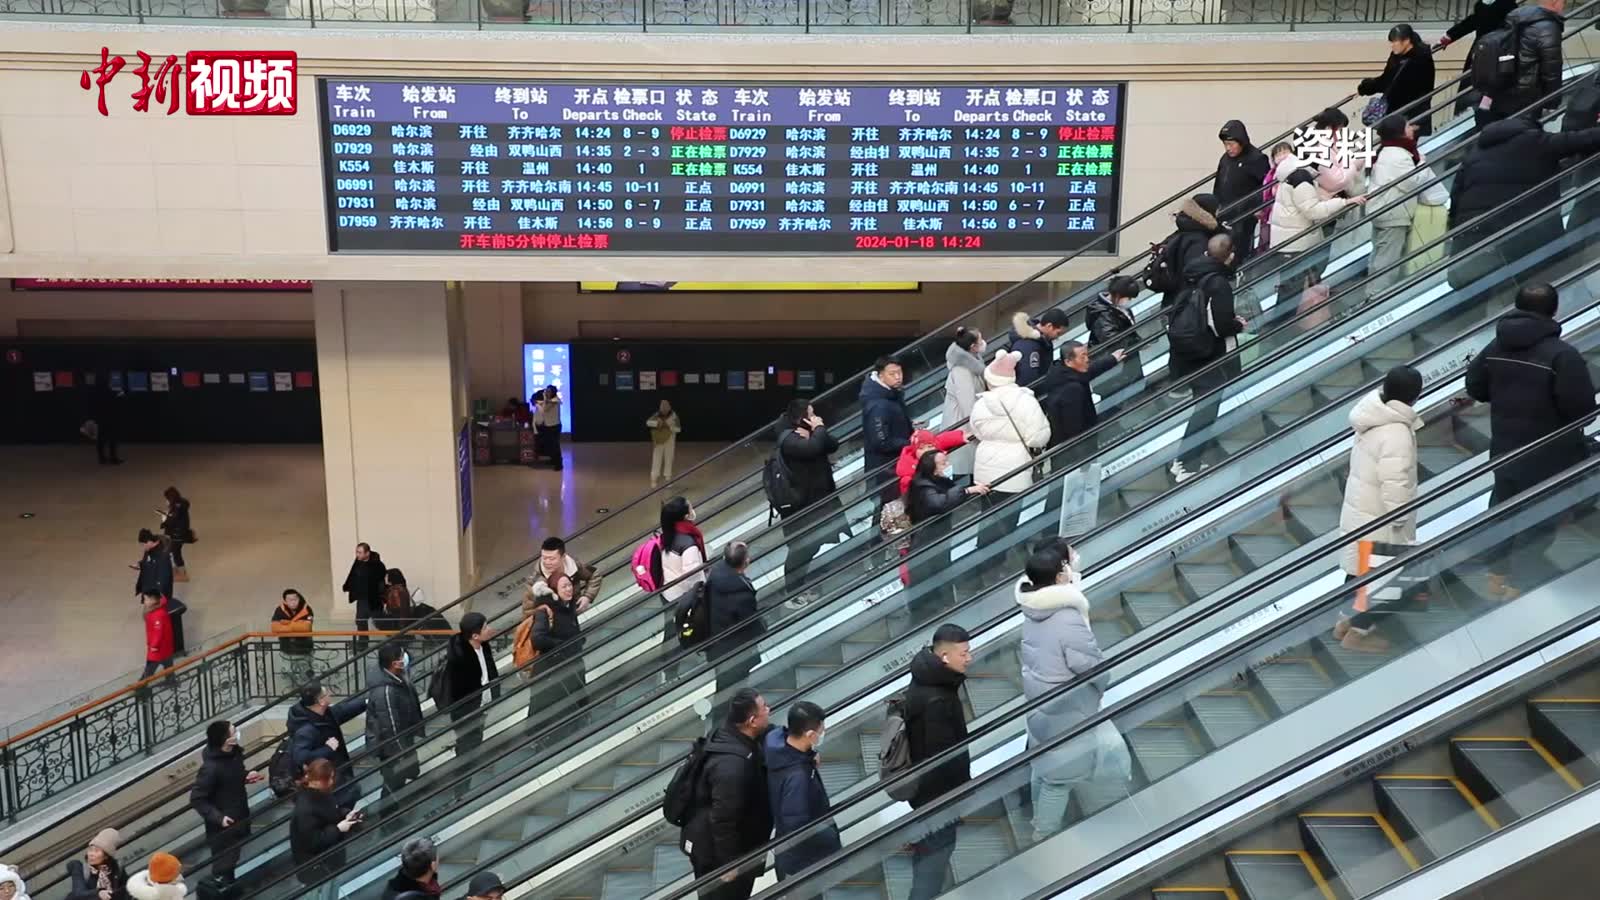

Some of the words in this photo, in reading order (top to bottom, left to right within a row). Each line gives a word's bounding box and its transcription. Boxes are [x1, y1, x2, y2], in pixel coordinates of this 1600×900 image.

[336, 84, 371, 101] 车次
[402, 86, 455, 103] 始发站
[495, 87, 547, 104] 终到站
[574, 88, 608, 104] 开点
[614, 88, 664, 105] 检票口
[735, 88, 768, 106] 车次
[799, 89, 851, 106] 始发站
[889, 89, 941, 106] 终到站
[966, 89, 1000, 106] 开点
[1005, 89, 1056, 106] 检票口
[334, 105, 375, 117] Train
[414, 107, 447, 118] From
[512, 108, 528, 119] To
[563, 108, 618, 122] Departs
[623, 109, 662, 120] Check
[677, 109, 716, 121] State
[732, 110, 771, 121] Train
[809, 110, 840, 121] From
[905, 110, 920, 121] To
[955, 110, 1009, 123] Departs
[1013, 110, 1052, 121] Check
[1066, 110, 1105, 121] State
[334, 124, 371, 135] D6929
[392, 125, 432, 137] 哈尔滨
[460, 125, 487, 138] 开往
[508, 126, 561, 139] 齐齐哈尔
[576, 127, 610, 138] 14:24
[671, 127, 727, 141] 停止检票
[730, 129, 766, 139] D6929
[786, 128, 825, 141] 哈尔滨
[852, 127, 879, 141] 开往
[899, 128, 952, 141] 齐齐哈尔
[965, 129, 1000, 139] 14:24
[1059, 127, 1114, 141] 停止检票
[335, 143, 372, 154] D7929
[393, 143, 433, 156] 哈尔滨
[470, 144, 497, 157] 经由
[509, 144, 562, 157] 双鸭山西
[576, 146, 611, 156] 14:35
[671, 145, 727, 159] 正在检票
[730, 147, 766, 157] D7929
[786, 146, 825, 158] 哈尔滨
[899, 145, 951, 159] 双鸭山西
[965, 147, 999, 157] 14:35
[1058, 145, 1113, 159] 正在检票
[340, 161, 369, 172] K554
[394, 160, 434, 174] 佳木斯
[461, 161, 489, 174] 开往
[523, 162, 548, 174] 温州
[577, 163, 612, 173] 14:40
[671, 163, 727, 176] 正在检票
[734, 164, 762, 175] K554
[786, 164, 825, 176] 佳木斯
[851, 163, 878, 176] 开往
[911, 164, 936, 176] 温州
[964, 164, 998, 174] 14:40
[1057, 163, 1112, 176] 正在检票
[337, 179, 372, 190] D6991
[395, 179, 435, 192] 哈尔滨
[462, 179, 490, 192] 开往
[502, 180, 571, 193] 齐齐哈尔南
[577, 181, 612, 192] 14:45
[626, 182, 658, 192] 10-11
[685, 181, 712, 194] 正点
[730, 182, 764, 193] D6991
[786, 181, 825, 194] 哈尔滨
[851, 181, 877, 194] 开往
[890, 181, 958, 194] 齐齐哈尔南
[964, 183, 998, 193] 14:45
[1011, 182, 1043, 193] 10-11
[1070, 180, 1096, 193] 正点
[339, 197, 374, 208] D7931
[396, 197, 436, 210] 哈尔滨
[473, 198, 500, 211] 经由
[511, 198, 563, 211] 双鸭山西
[578, 199, 612, 210] 14:50
[685, 199, 712, 211] 正点
[730, 200, 764, 211] D7931
[786, 200, 824, 212] 哈尔滨
[898, 199, 949, 212] 双鸭山西
[963, 200, 997, 210] 14:50
[1069, 198, 1095, 211] 正点
[340, 216, 376, 227] D7959
[390, 216, 443, 229] 齐齐哈尔
[464, 216, 491, 229] 开往
[518, 217, 557, 229] 佳木斯
[578, 218, 613, 228] 14:56
[685, 217, 712, 230] 正点
[730, 219, 766, 229] D7959
[779, 218, 831, 230] 齐齐哈尔
[850, 217, 877, 230] 开往
[903, 218, 942, 230] 佳木斯
[962, 218, 996, 229] 14:56
[1067, 216, 1094, 229] 正点
[460, 235, 608, 249] 开车前5分钟停止检票
[856, 237, 934, 248] 2024-01-18
[942, 237, 980, 248] 14:24
